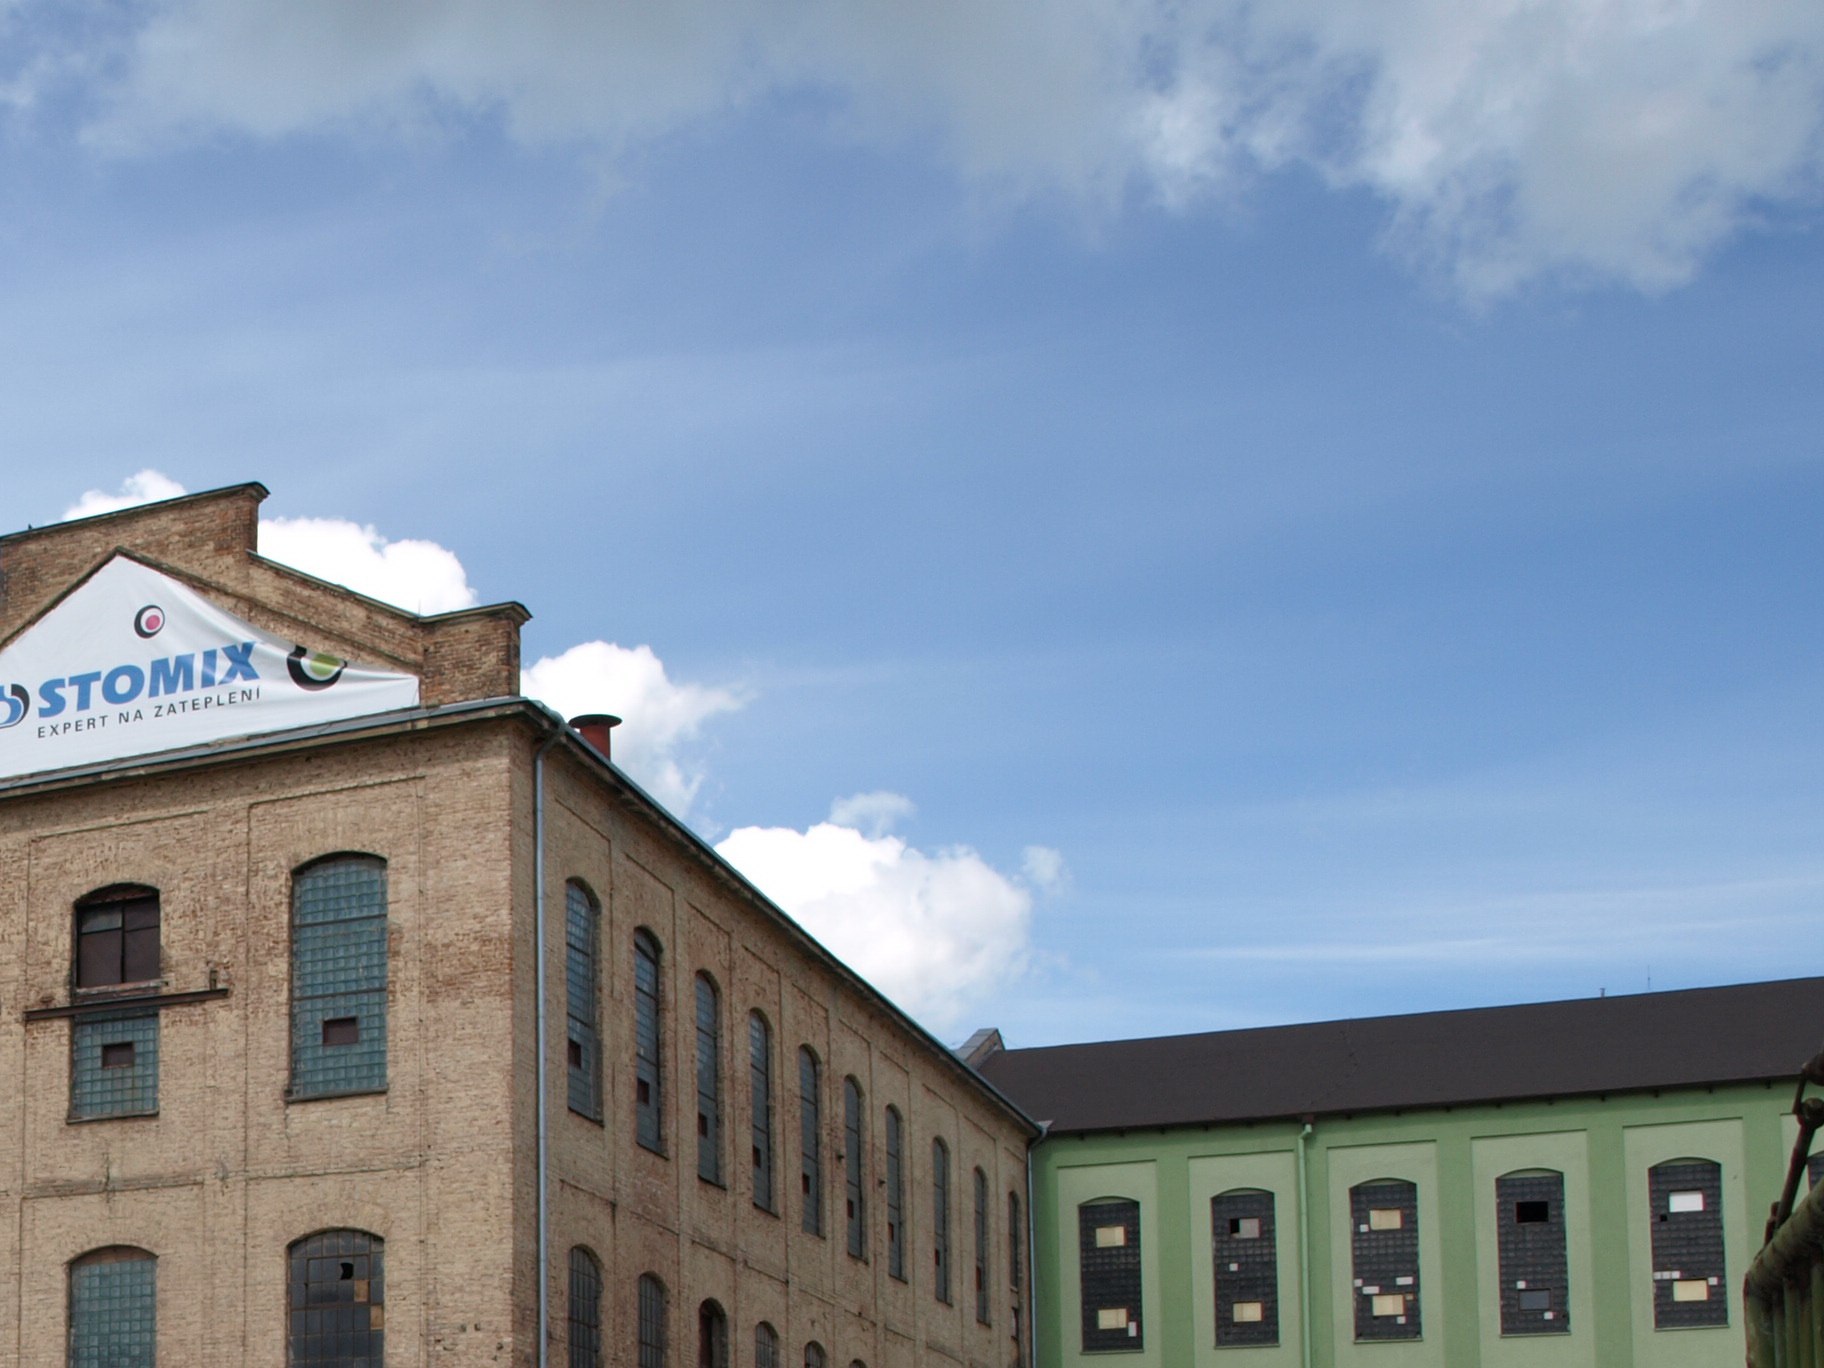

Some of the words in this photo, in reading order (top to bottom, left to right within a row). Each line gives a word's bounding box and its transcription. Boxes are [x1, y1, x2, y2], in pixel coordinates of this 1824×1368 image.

[38, 641, 260, 718] STOMIX
[37, 714, 108, 739] EXPERT
[118, 708, 144, 724] NA
[154, 686, 261, 718] ZATEPLENÍ
